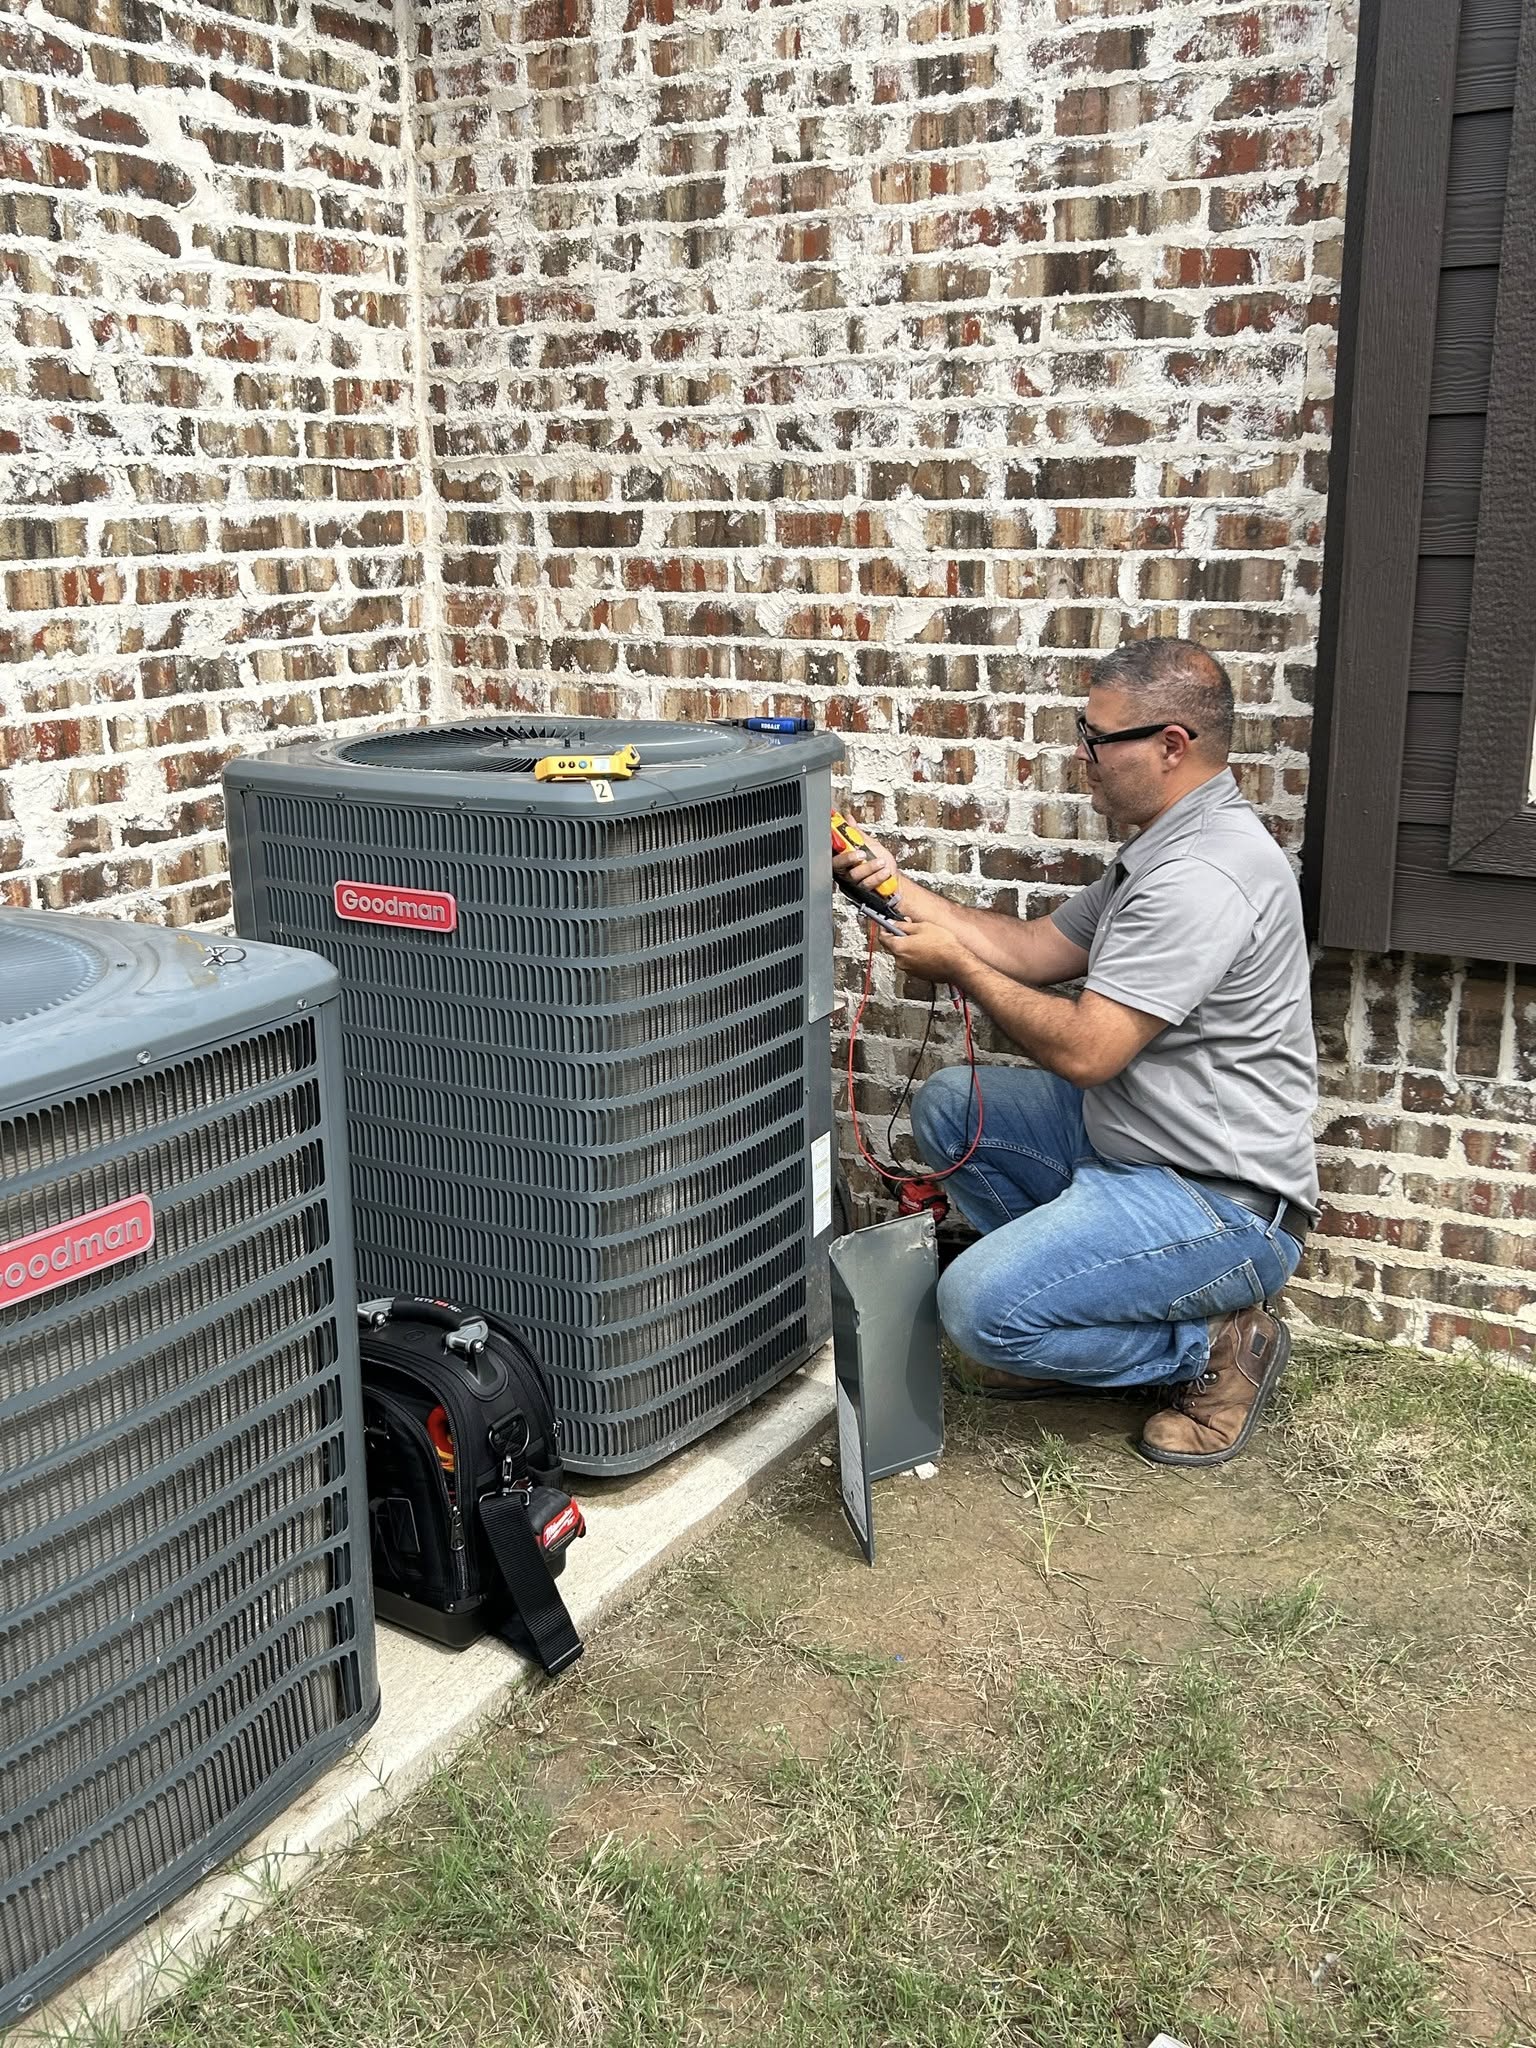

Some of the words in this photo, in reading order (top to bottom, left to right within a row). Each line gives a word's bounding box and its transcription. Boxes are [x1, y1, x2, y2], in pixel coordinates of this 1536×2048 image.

[596, 783, 608, 798] 2
[341, 889, 446, 922] Goodman
[0, 1216, 144, 1288] oodman
